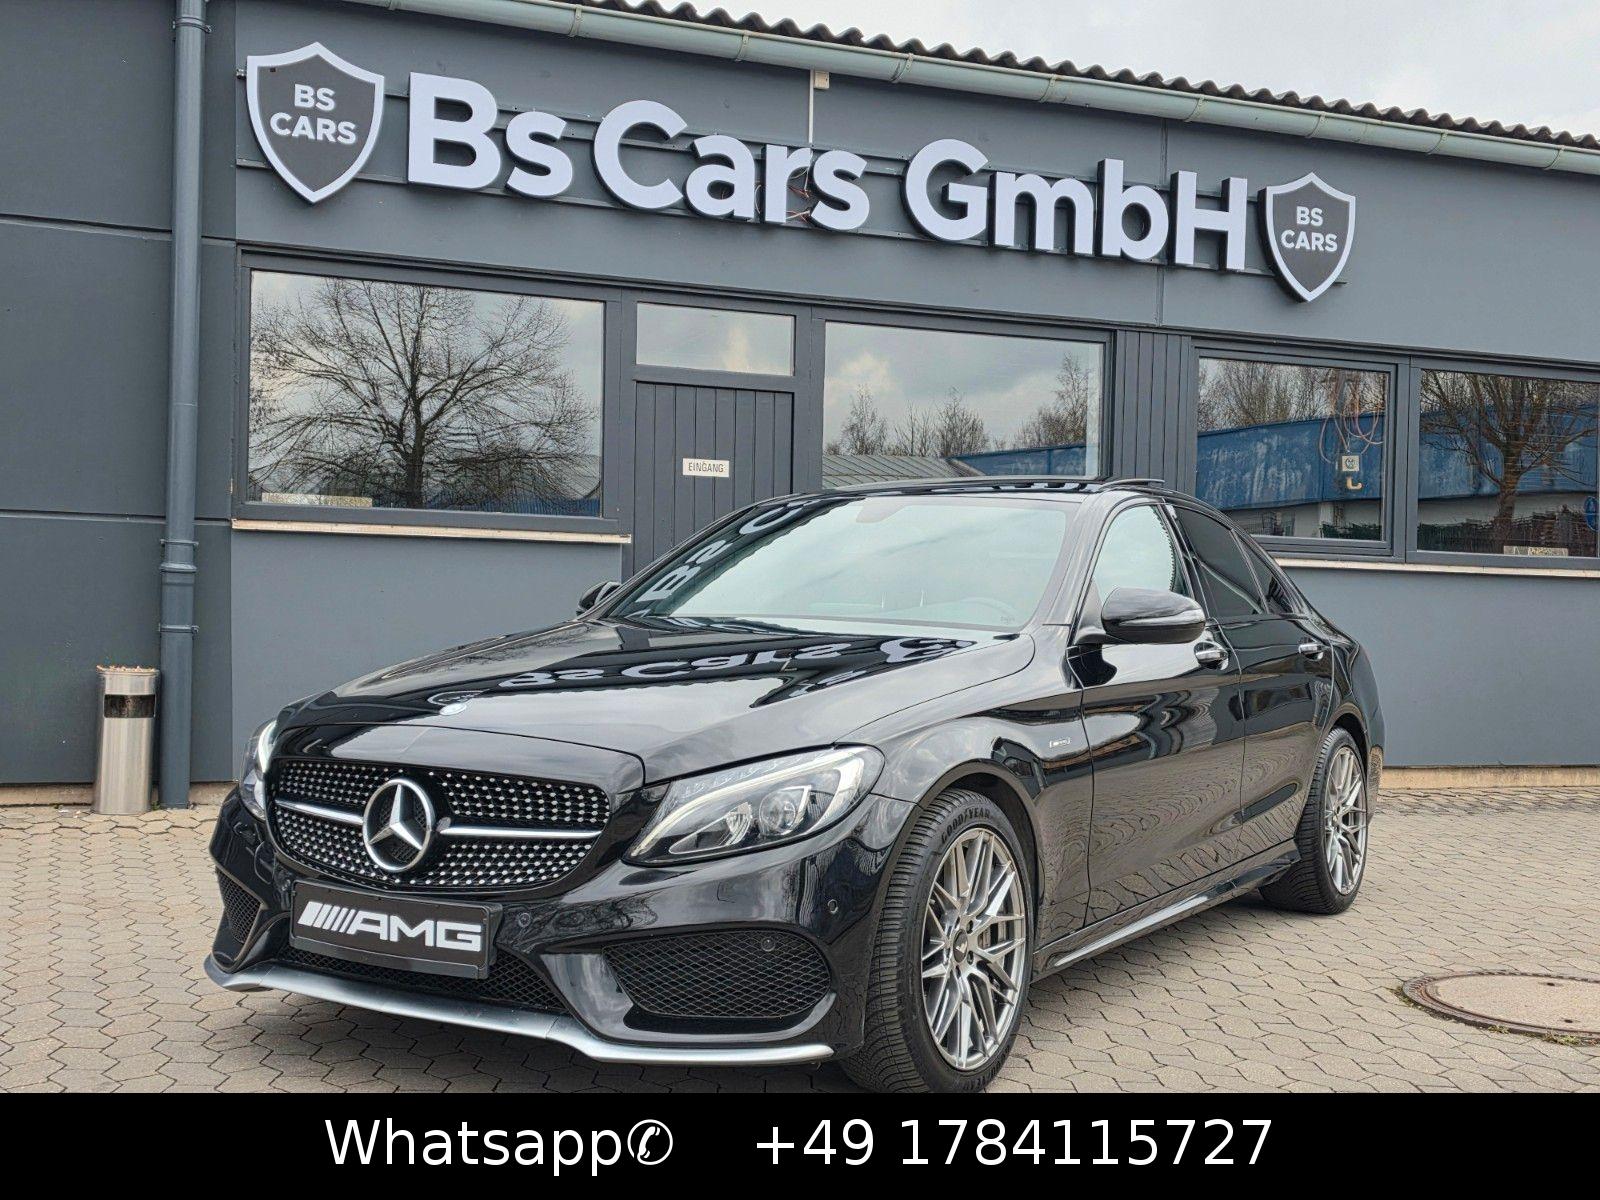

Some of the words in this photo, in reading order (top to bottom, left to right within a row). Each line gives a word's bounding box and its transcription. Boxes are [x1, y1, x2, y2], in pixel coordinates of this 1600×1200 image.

[294, 83, 336, 112] BS
[269, 111, 357, 146] CARS
[904, 138, 1248, 271] GmbH
[1296, 205, 1324, 227] BS
[1280, 229, 1338, 253] CARS
[688, 462, 724, 473] EINGANG
[346, 910, 482, 953] AMG
